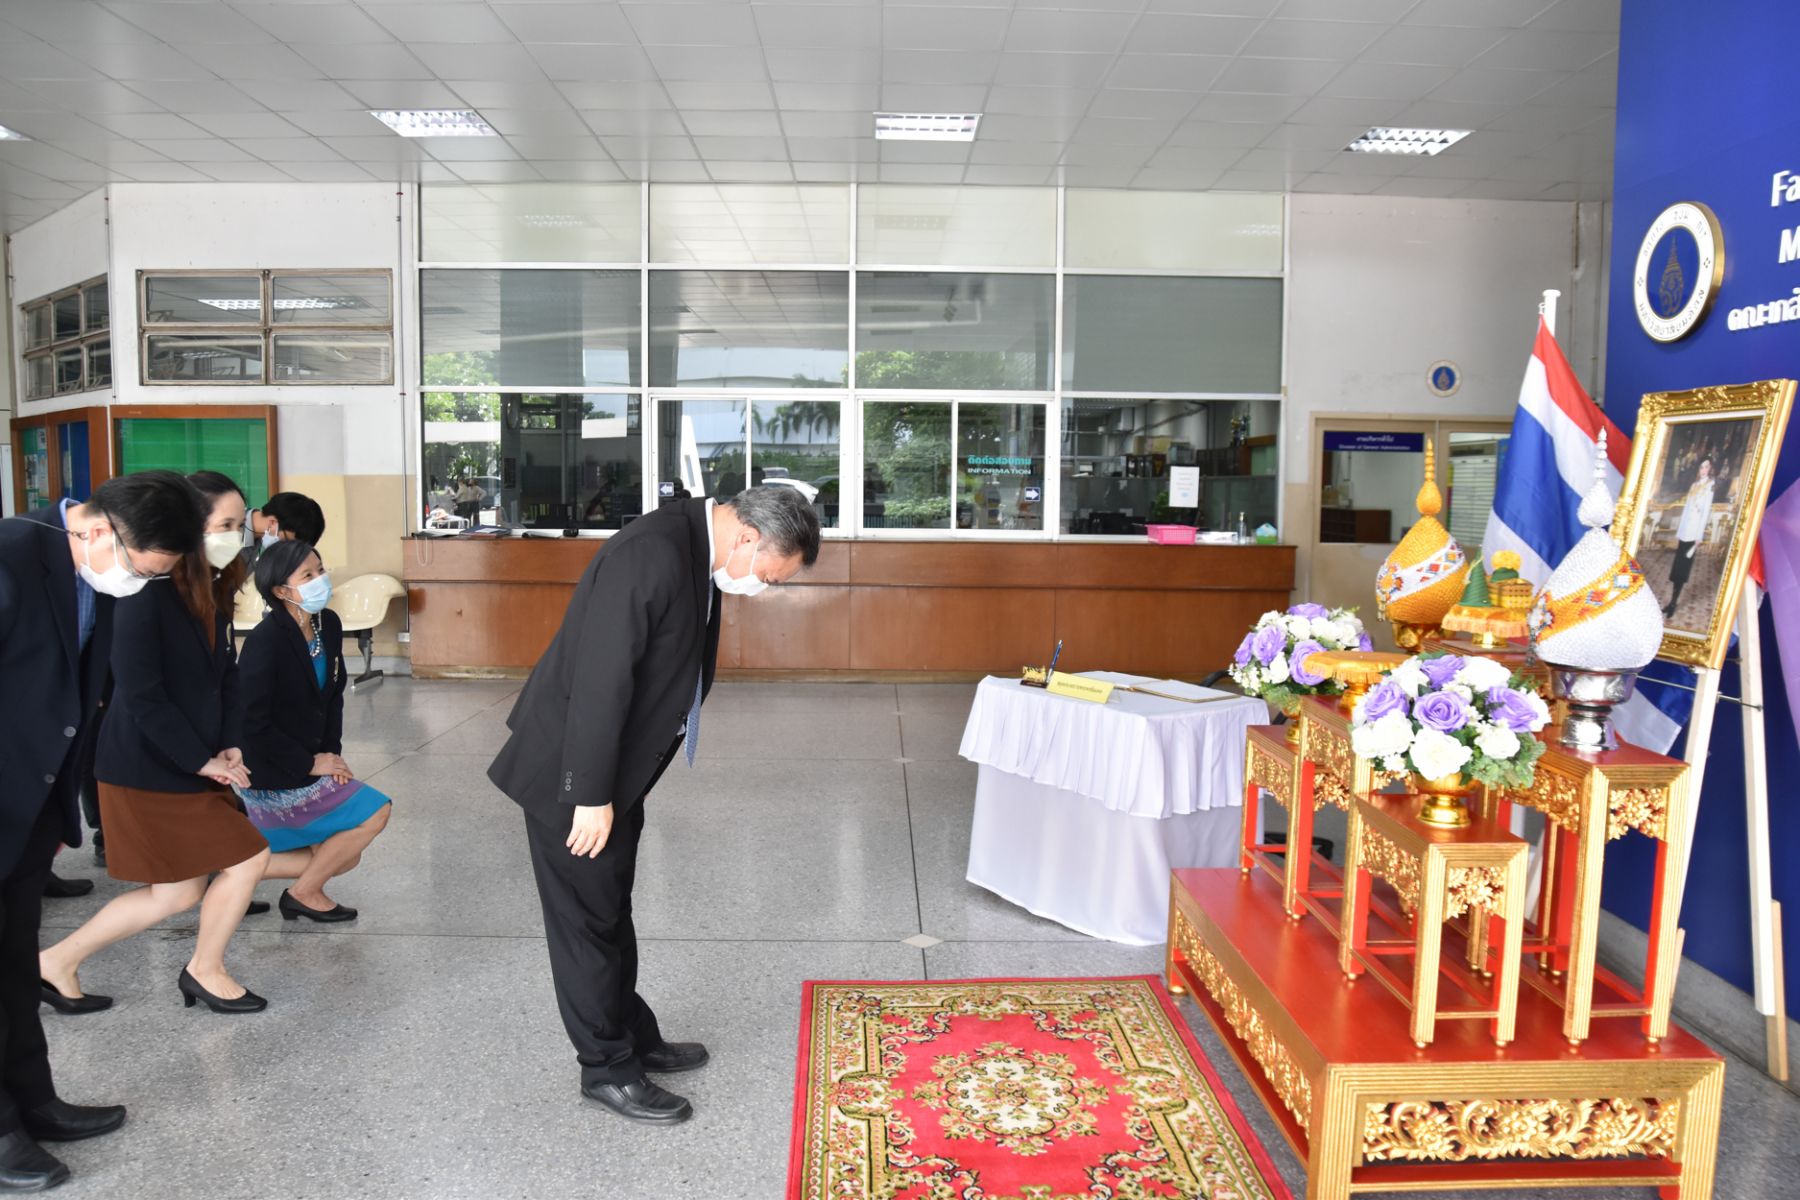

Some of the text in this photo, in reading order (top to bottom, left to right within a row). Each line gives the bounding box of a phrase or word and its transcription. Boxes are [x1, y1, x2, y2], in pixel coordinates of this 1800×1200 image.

[1771, 170, 1800, 207] Fa
[1778, 225, 1800, 264] M
[967, 455, 1032, 465] ติดต่อสอบถาม
[967, 467, 1032, 475] INFORMATION
